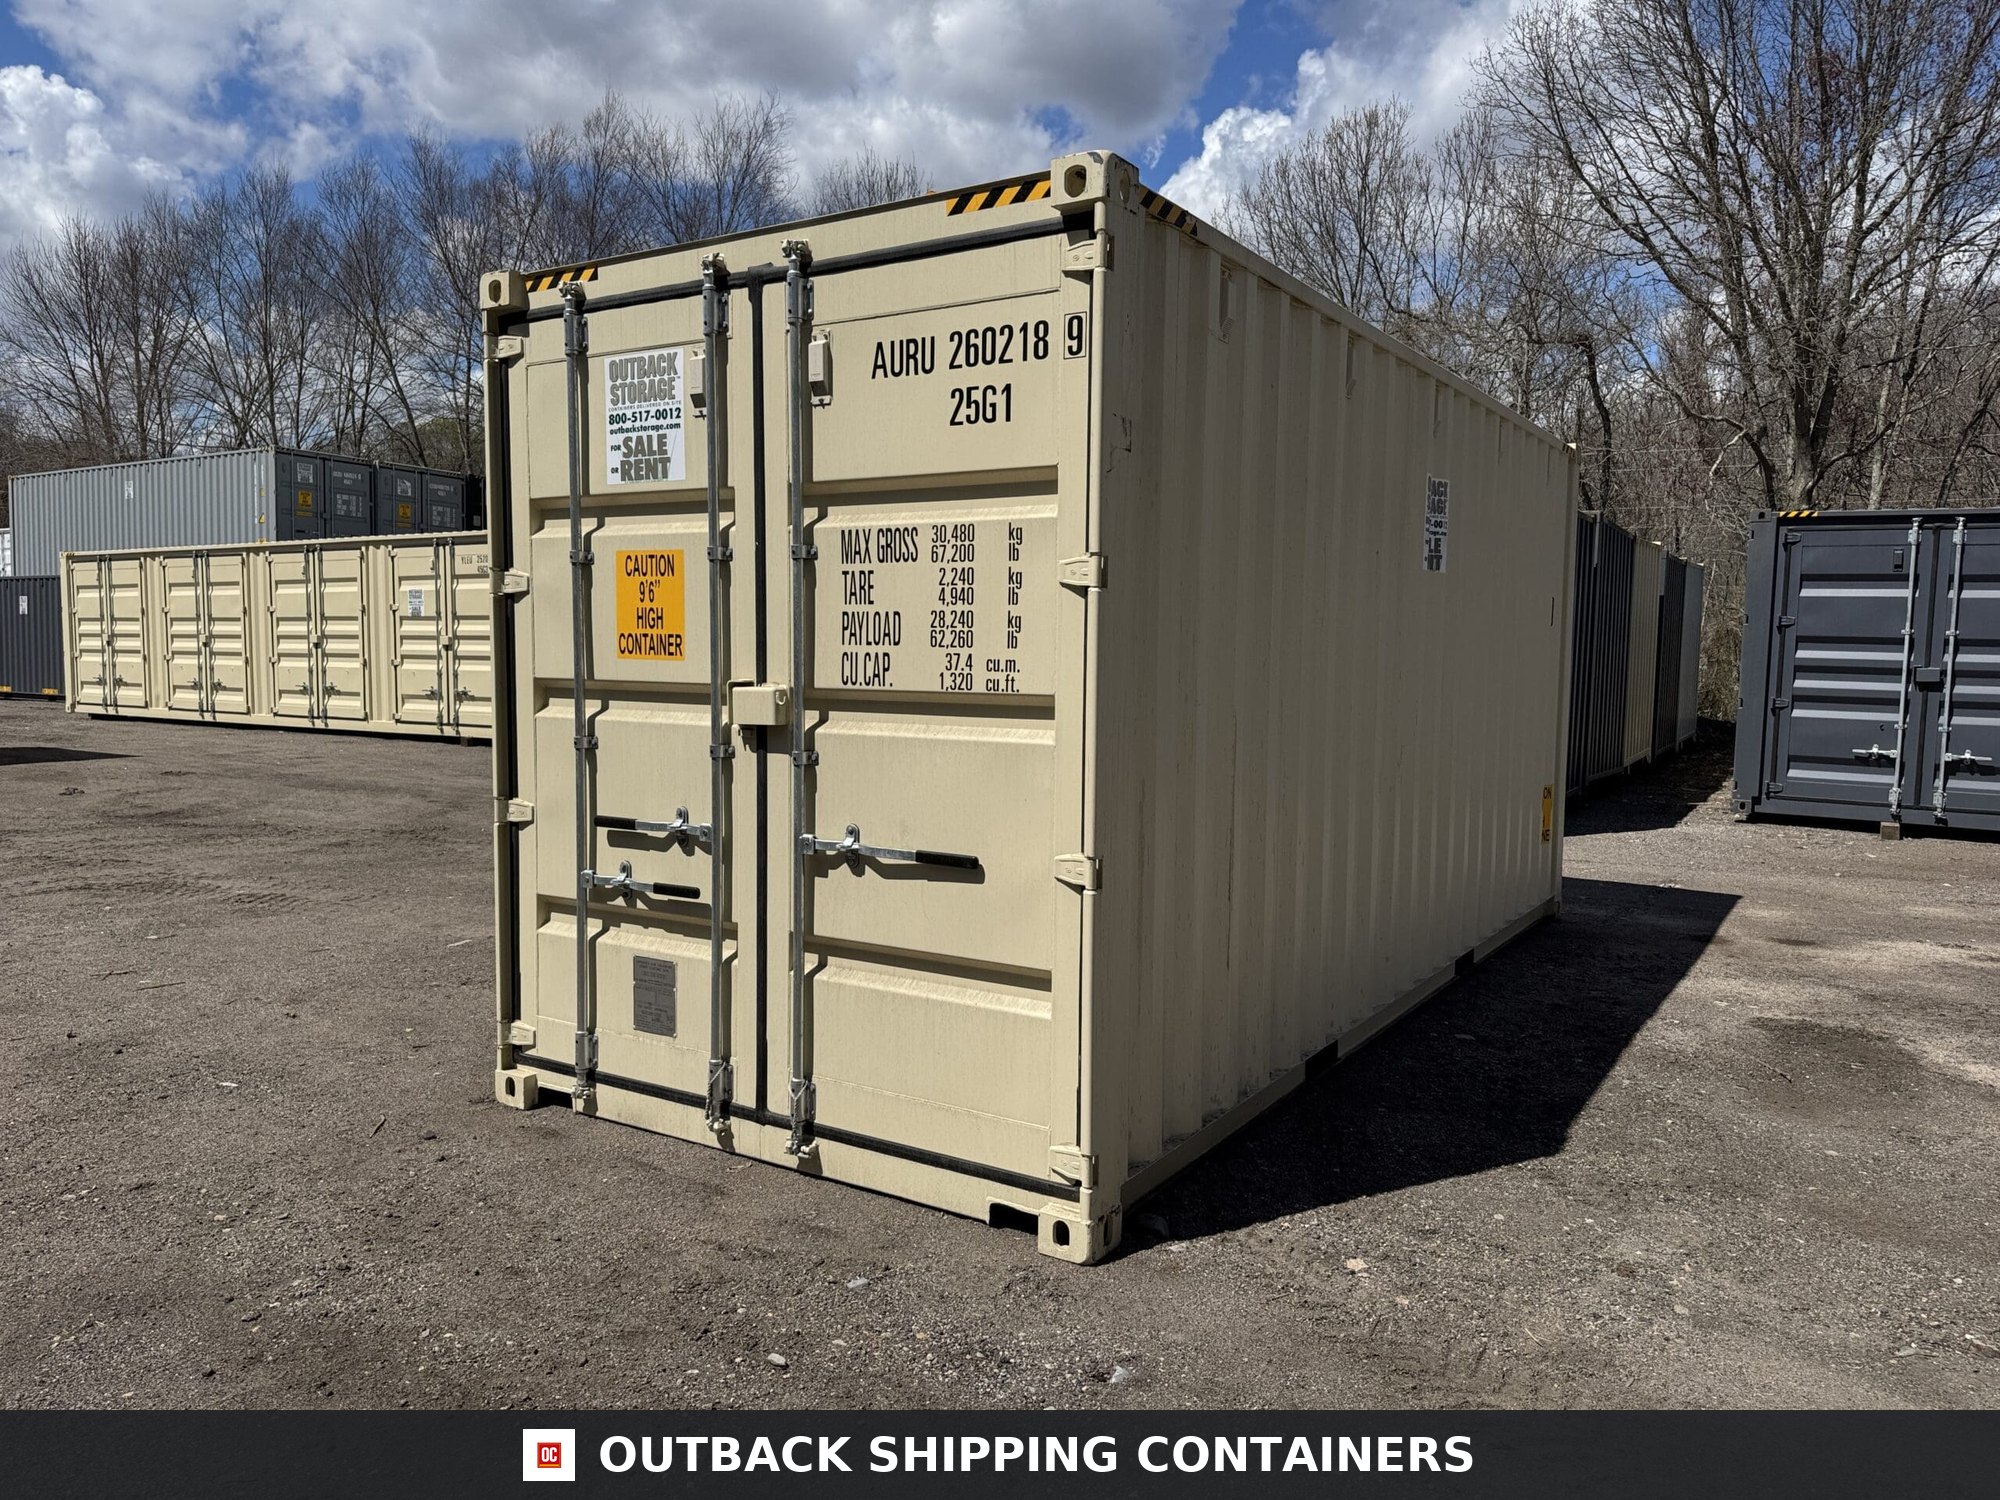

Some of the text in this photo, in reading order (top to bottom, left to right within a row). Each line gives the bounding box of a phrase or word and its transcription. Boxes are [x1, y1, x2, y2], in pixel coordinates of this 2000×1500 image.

[872, 315, 1083, 379] AURU 260218 9
[609, 352, 678, 382] OUTBACK
[610, 376, 676, 406] STORAGE
[609, 407, 681, 425] 800-517-0012
[950, 383, 1012, 426] 25G1
[610, 423, 680, 435] outbackstorage.com
[622, 434, 668, 458] SALE
[620, 457, 671, 481] RENT
[841, 522, 1023, 564] MAX GROSS 30,480 kg
[931, 542, 1019, 564] 67,200 lb
[625, 554, 675, 577] CAUTION
[842, 566, 1022, 605] TARE 2,240 kg
[938, 586, 1018, 607] 4,940 lb
[636, 607, 663, 629] HIGH
[842, 610, 1021, 646] PAYLOAD 28,240 kg
[619, 633, 682, 656] CONTAINER
[930, 630, 1018, 649] 62,260 lb
[842, 652, 1020, 687] CU.CAP. 37.4 cu.m.
[939, 672, 1019, 693] 1,320 cu.ft.
